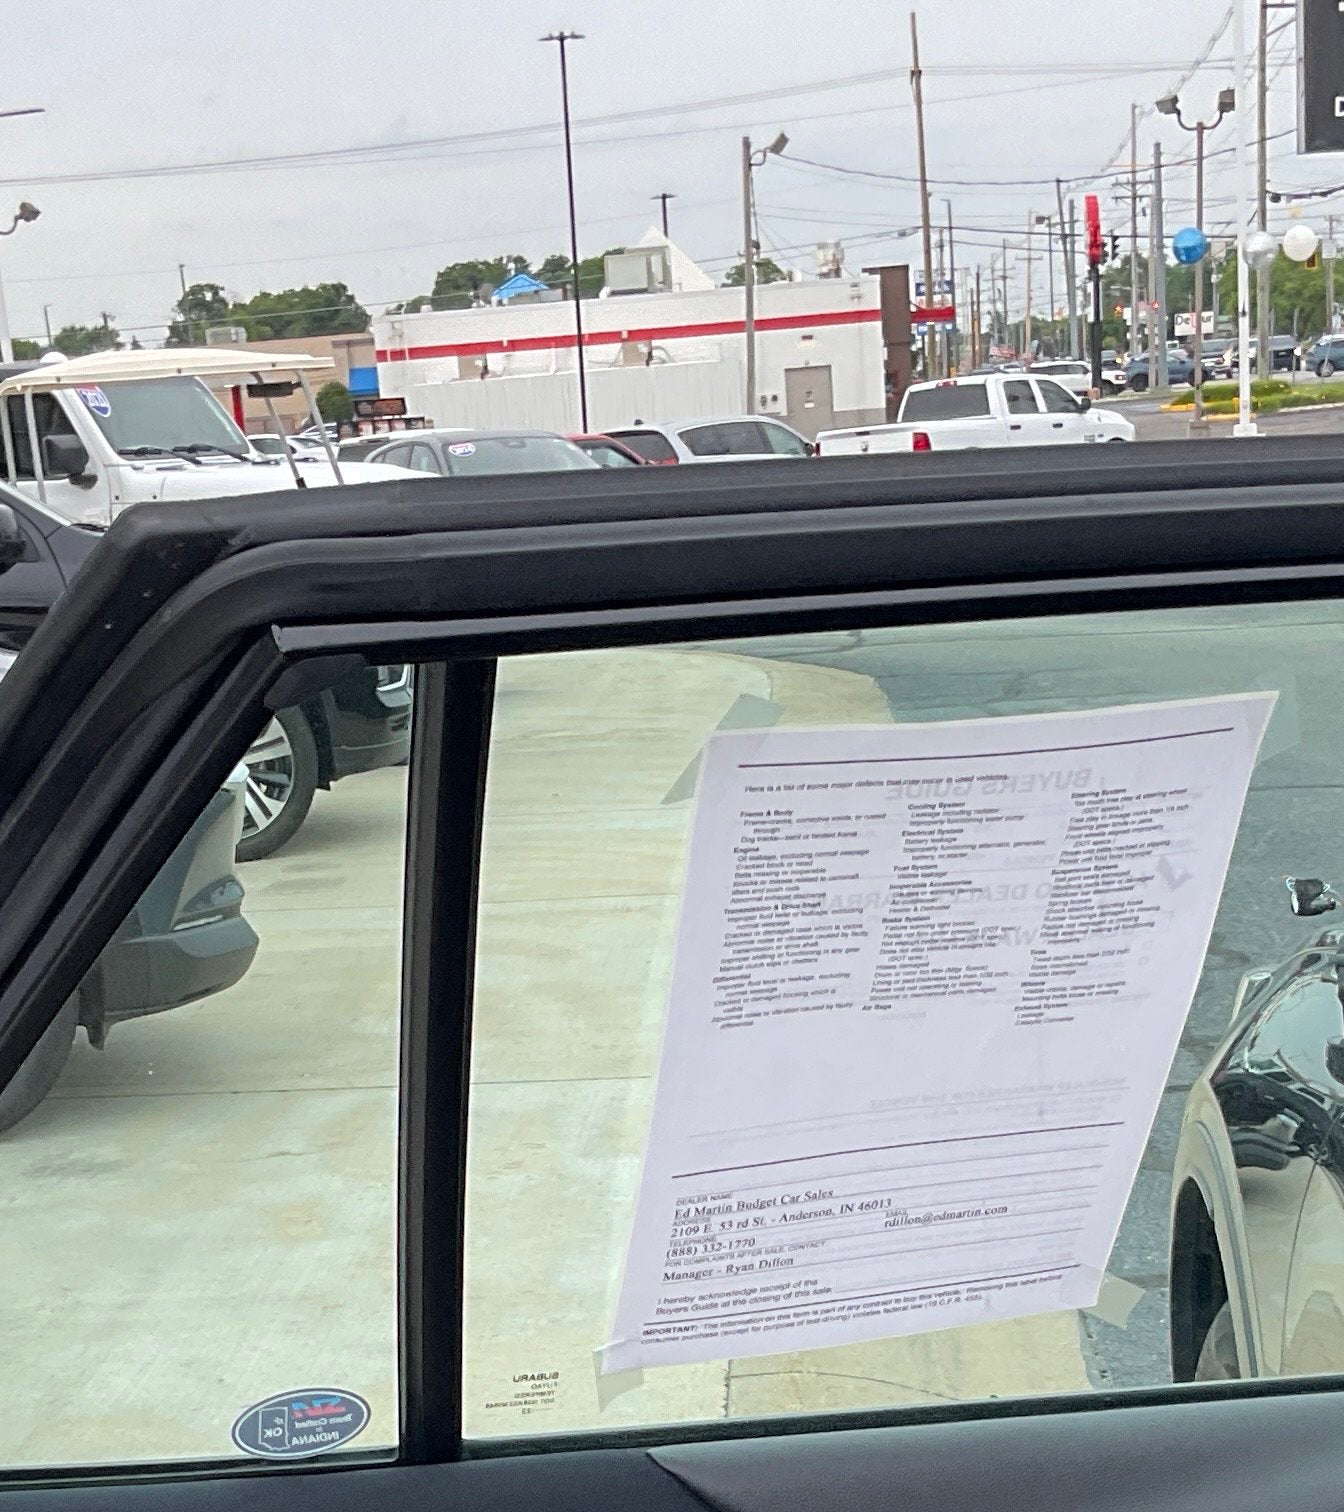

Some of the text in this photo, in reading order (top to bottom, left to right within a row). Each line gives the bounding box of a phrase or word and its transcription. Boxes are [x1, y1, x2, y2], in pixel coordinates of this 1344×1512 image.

[674, 1188, 834, 1220] Ed Martin Budget Car Sales
[884, 1205, 1008, 1228] rdillon@edmartin.com
[670, 1226, 700, 1238] 2109
[720, 1220, 732, 1230] 53
[736, 1218, 749, 1229] rd
[839, 1203, 855, 1215] IN
[857, 1199, 892, 1211] 46013
[666, 1237, 756, 1259] (888) 332-1770
[662, 1269, 714, 1283] Manager
[726, 1263, 755, 1275] Ryan
[656, 1305, 688, 1315] Buyers
[691, 1302, 719, 1311] Guide
[733, 1298, 746, 1307] the
[749, 1294, 781, 1304] closing
[783, 1290, 793, 1300] of
[795, 1288, 809, 1297] this
[664, 1294, 696, 1304] hereby
[698, 1288, 757, 1301] acknowledge
[792, 1280, 802, 1289] of
[804, 1278, 818, 1287] the
